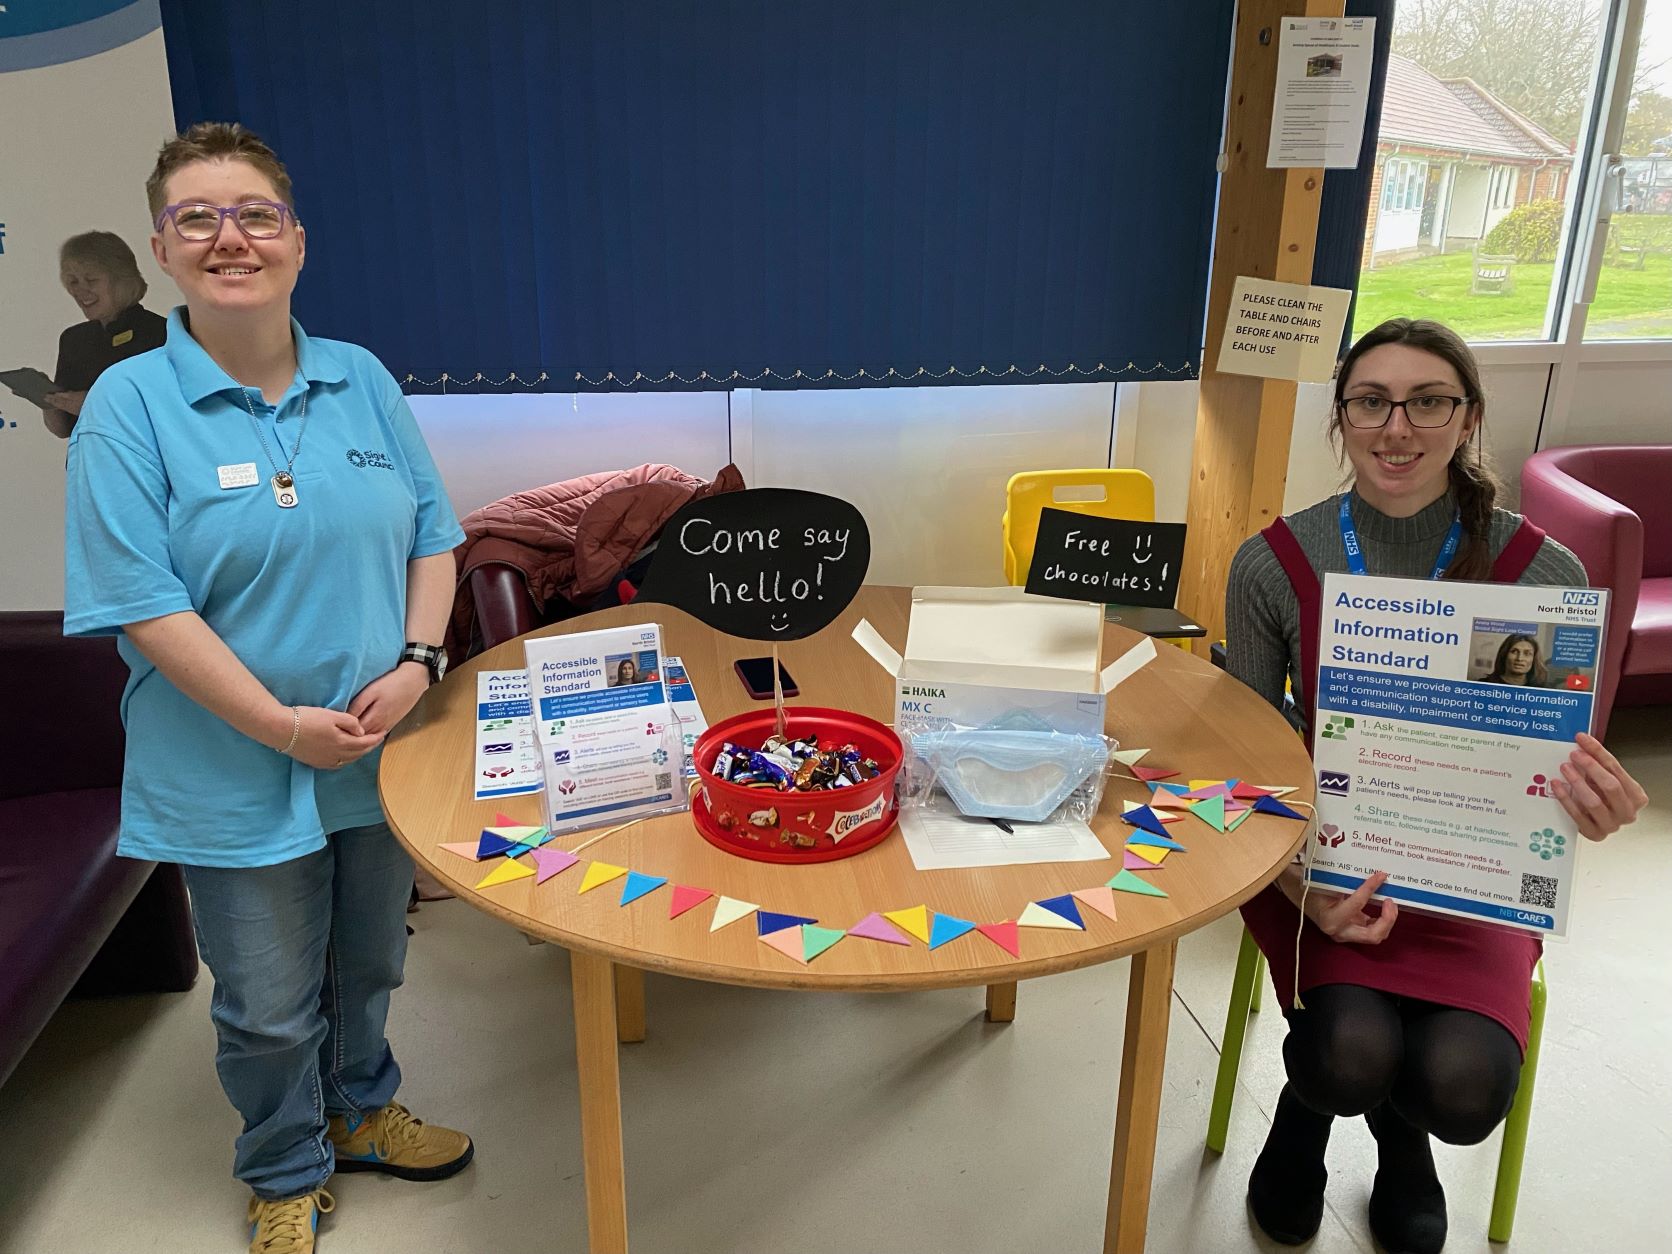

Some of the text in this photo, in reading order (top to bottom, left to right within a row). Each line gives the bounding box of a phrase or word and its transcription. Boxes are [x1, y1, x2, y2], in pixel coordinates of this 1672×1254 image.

[1242, 293, 1324, 312] PLEASE CLEAN THE
[1240, 310, 1322, 328] TABLE AND CHAIRS
[1236, 326, 1320, 344] BEFORE AND AFTER
[1232, 342, 1276, 355] EACH USE
[680, 518, 850, 561] Come say
[1064, 530, 1110, 556] Free
[1344, 531, 1359, 555] NHS
[708, 562, 824, 604] hello!
[1044, 562, 1168, 592] chocolates!
[1335, 592, 1455, 616] Accessible
[1538, 605, 1597, 616] North Bristol
[1564, 592, 1598, 605] NHS
[1334, 618, 1459, 646] Information
[542, 657, 598, 671] Accessible
[1332, 646, 1430, 670] Standard
[543, 669, 601, 682] Information
[544, 680, 590, 694] Standard
[912, 686, 946, 698] HAIKA
[1330, 670, 1578, 706] Let's ensure we provide accessible information
[902, 701, 932, 713] MX C
[1329, 696, 1348, 704] with
[1360, 699, 1406, 714] disability,
[1409, 706, 1468, 720] impairment
[1486, 716, 1528, 730] sensory
[1532, 721, 1558, 732] loss.
[1351, 686, 1428, 702] communication
[1430, 696, 1471, 708] support
[1474, 701, 1484, 710] to
[1488, 704, 1527, 715] service
[1530, 708, 1562, 718] users
[1362, 720, 1371, 729] 1.
[1374, 721, 1394, 731] Ask
[1470, 738, 1495, 746] parent
[1504, 742, 1520, 751] they
[1394, 735, 1449, 748] communication
[1358, 748, 1369, 756] 2.
[1372, 749, 1412, 763] Record
[1414, 758, 1435, 766] these
[1436, 762, 1460, 770] needs
[1480, 768, 1512, 779] patient's
[1358, 759, 1392, 768] electronic
[1356, 786, 1385, 796] patient's
[1413, 795, 1437, 804] please
[1465, 803, 1484, 812] them
[1357, 776, 1366, 784] 3.
[1369, 777, 1400, 790] Alerts
[1443, 792, 1465, 801] telling
[1354, 804, 1364, 813] 4.
[1368, 805, 1400, 818] Share
[1425, 818, 1446, 827] needs
[1354, 815, 1382, 824] referrals
[1399, 822, 1430, 833] following
[1450, 831, 1478, 841] sharing
[1351, 841, 1379, 852] different
[1407, 852, 1424, 860] book
[1426, 856, 1465, 867] assistance
[1352, 831, 1362, 840] 5.
[1365, 832, 1392, 845] Meet
[1408, 844, 1462, 857] communication
[1464, 853, 1487, 862] needs
[1489, 858, 1504, 866] e.g.
[1312, 857, 1335, 867] Search
[1464, 887, 1478, 895] find
[1493, 893, 1515, 903] more.
[1500, 908, 1546, 924] NBTCARES
